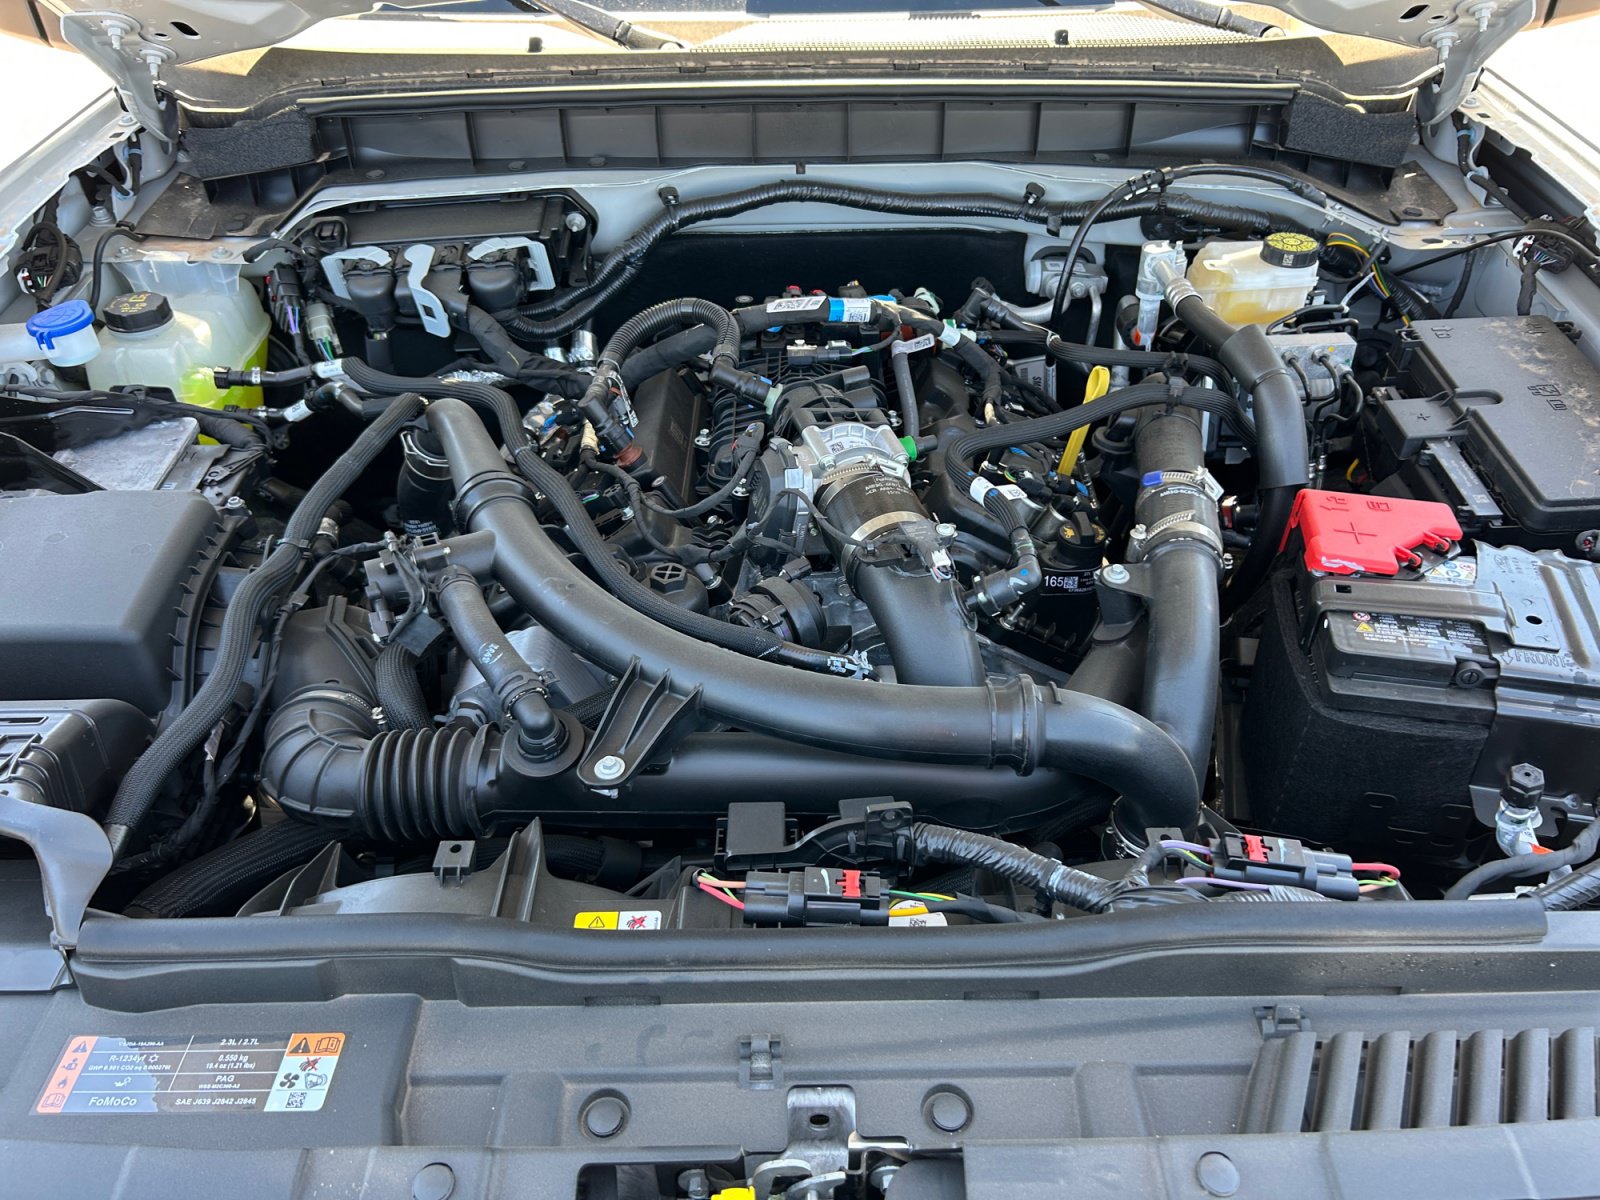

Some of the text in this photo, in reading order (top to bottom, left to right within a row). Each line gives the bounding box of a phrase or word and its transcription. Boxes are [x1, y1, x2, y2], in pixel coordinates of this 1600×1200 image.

[1044, 575, 1064, 587] 165
[1514, 650, 1567, 668] FRONT
[109, 1054, 147, 1063] R-1234yf
[239, 1054, 249, 1063] kg
[227, 1062, 242, 1070] (1.21
[88, 1096, 137, 1106] FoMoCo
[234, 1097, 257, 1105] J2845
